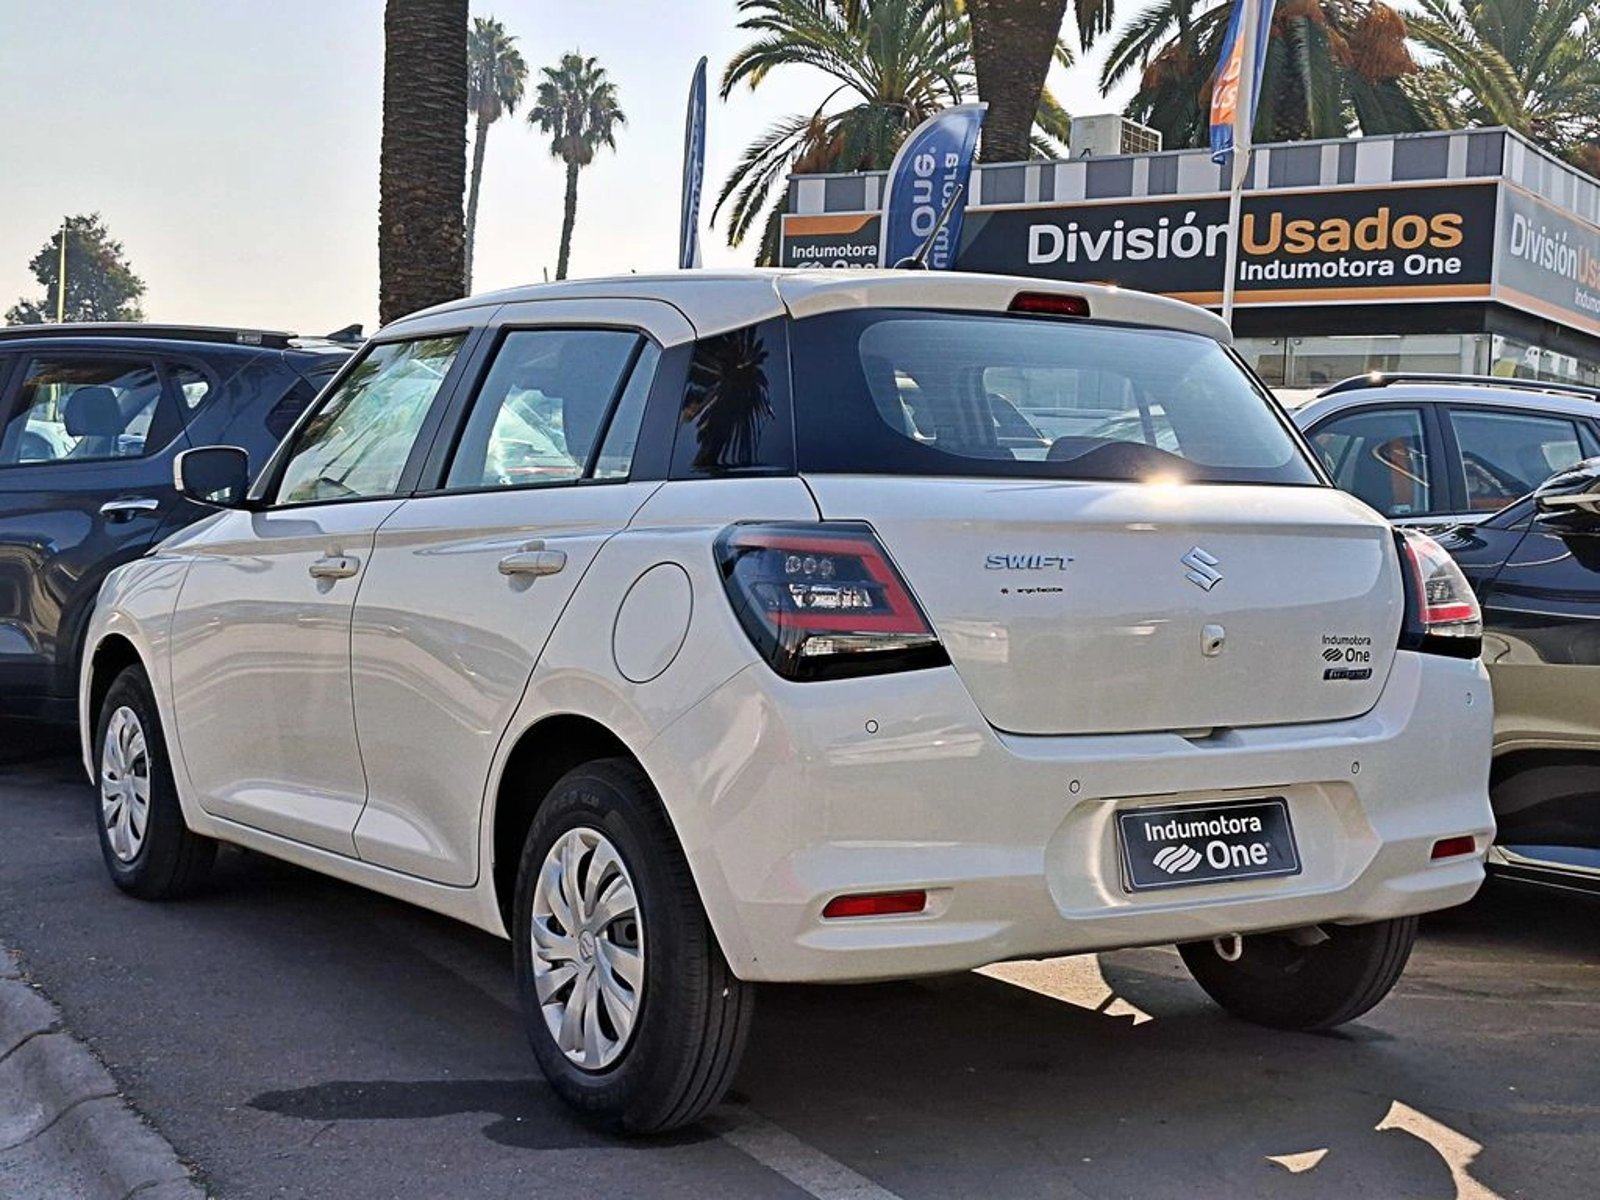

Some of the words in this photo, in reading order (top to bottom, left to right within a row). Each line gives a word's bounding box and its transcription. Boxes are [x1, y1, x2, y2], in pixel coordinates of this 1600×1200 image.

[1027, 211, 1232, 264] División
[1241, 206, 1464, 255] Usados
[1510, 213, 1578, 281] División
[792, 243, 878, 259] Indumotora
[1239, 258, 1395, 281] Indumotora
[1403, 254, 1462, 276] One
[984, 553, 1075, 571] SWIFT
[1321, 634, 1372, 646] Indumotora
[1345, 647, 1371, 663] One
[1144, 815, 1263, 842] Indumotora
[1206, 840, 1269, 870] One
